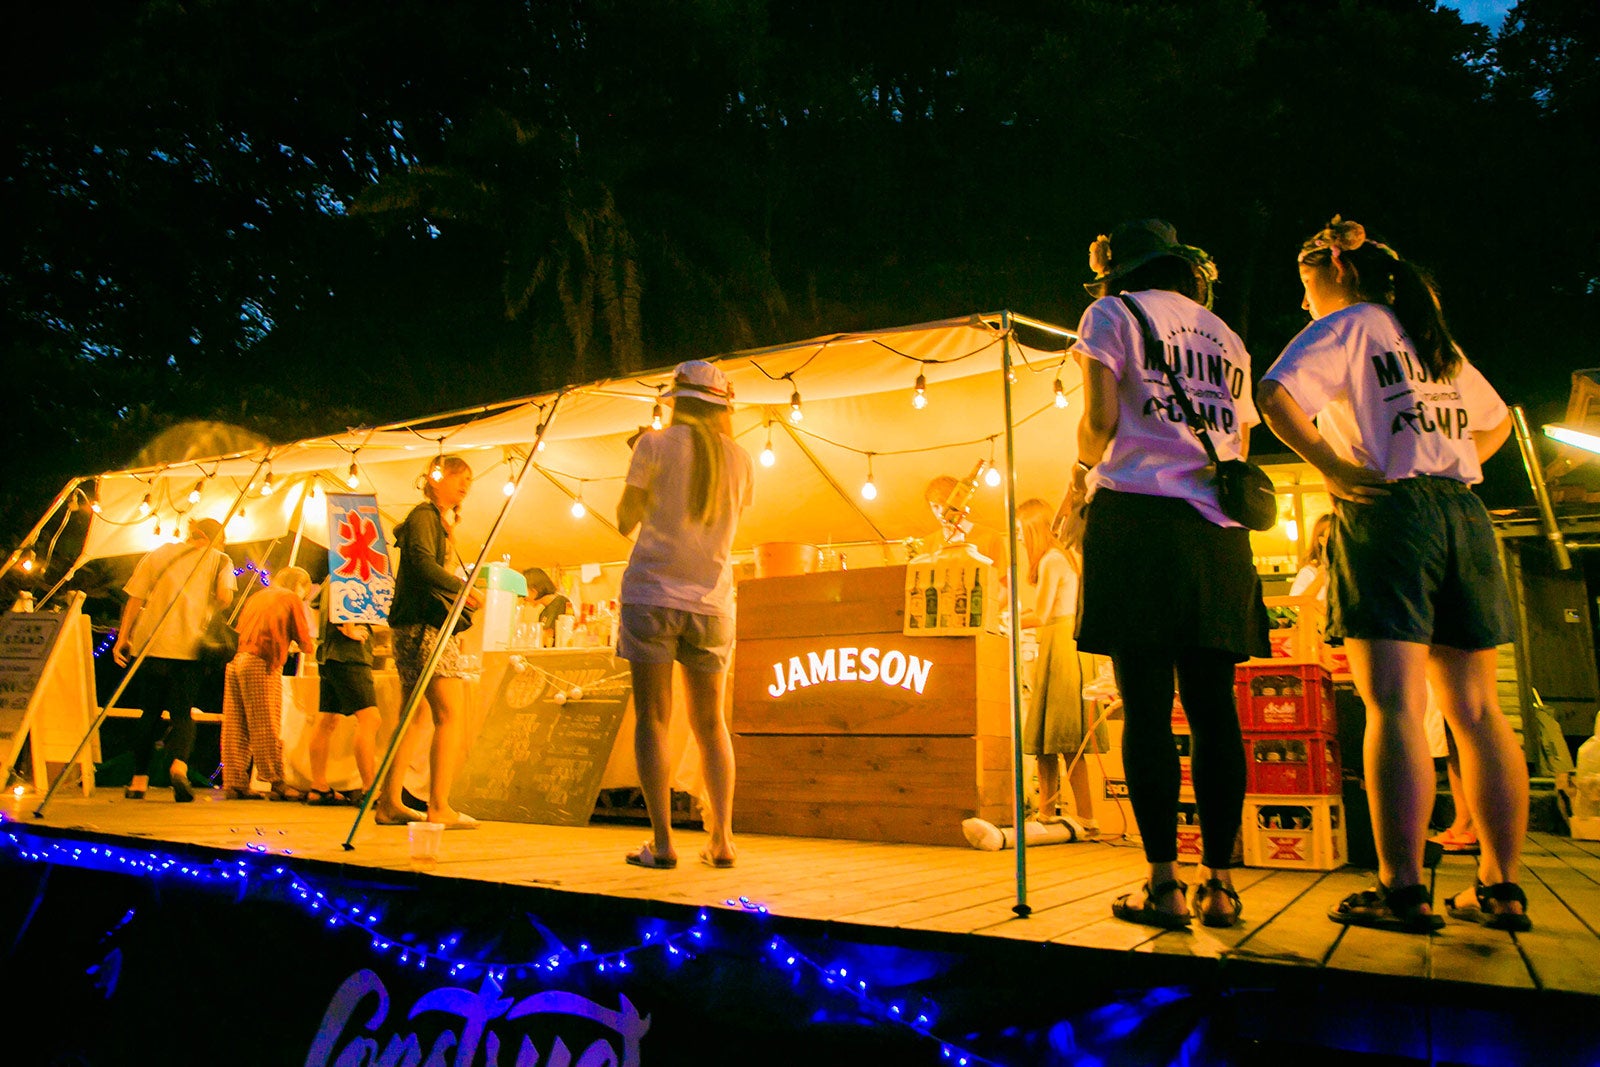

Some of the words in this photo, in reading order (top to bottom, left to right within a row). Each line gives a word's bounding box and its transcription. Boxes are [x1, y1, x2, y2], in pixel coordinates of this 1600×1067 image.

[1166, 394, 1234, 434] CMP
[334, 509, 389, 584] 氷
[768, 647, 934, 698] JAMESON
